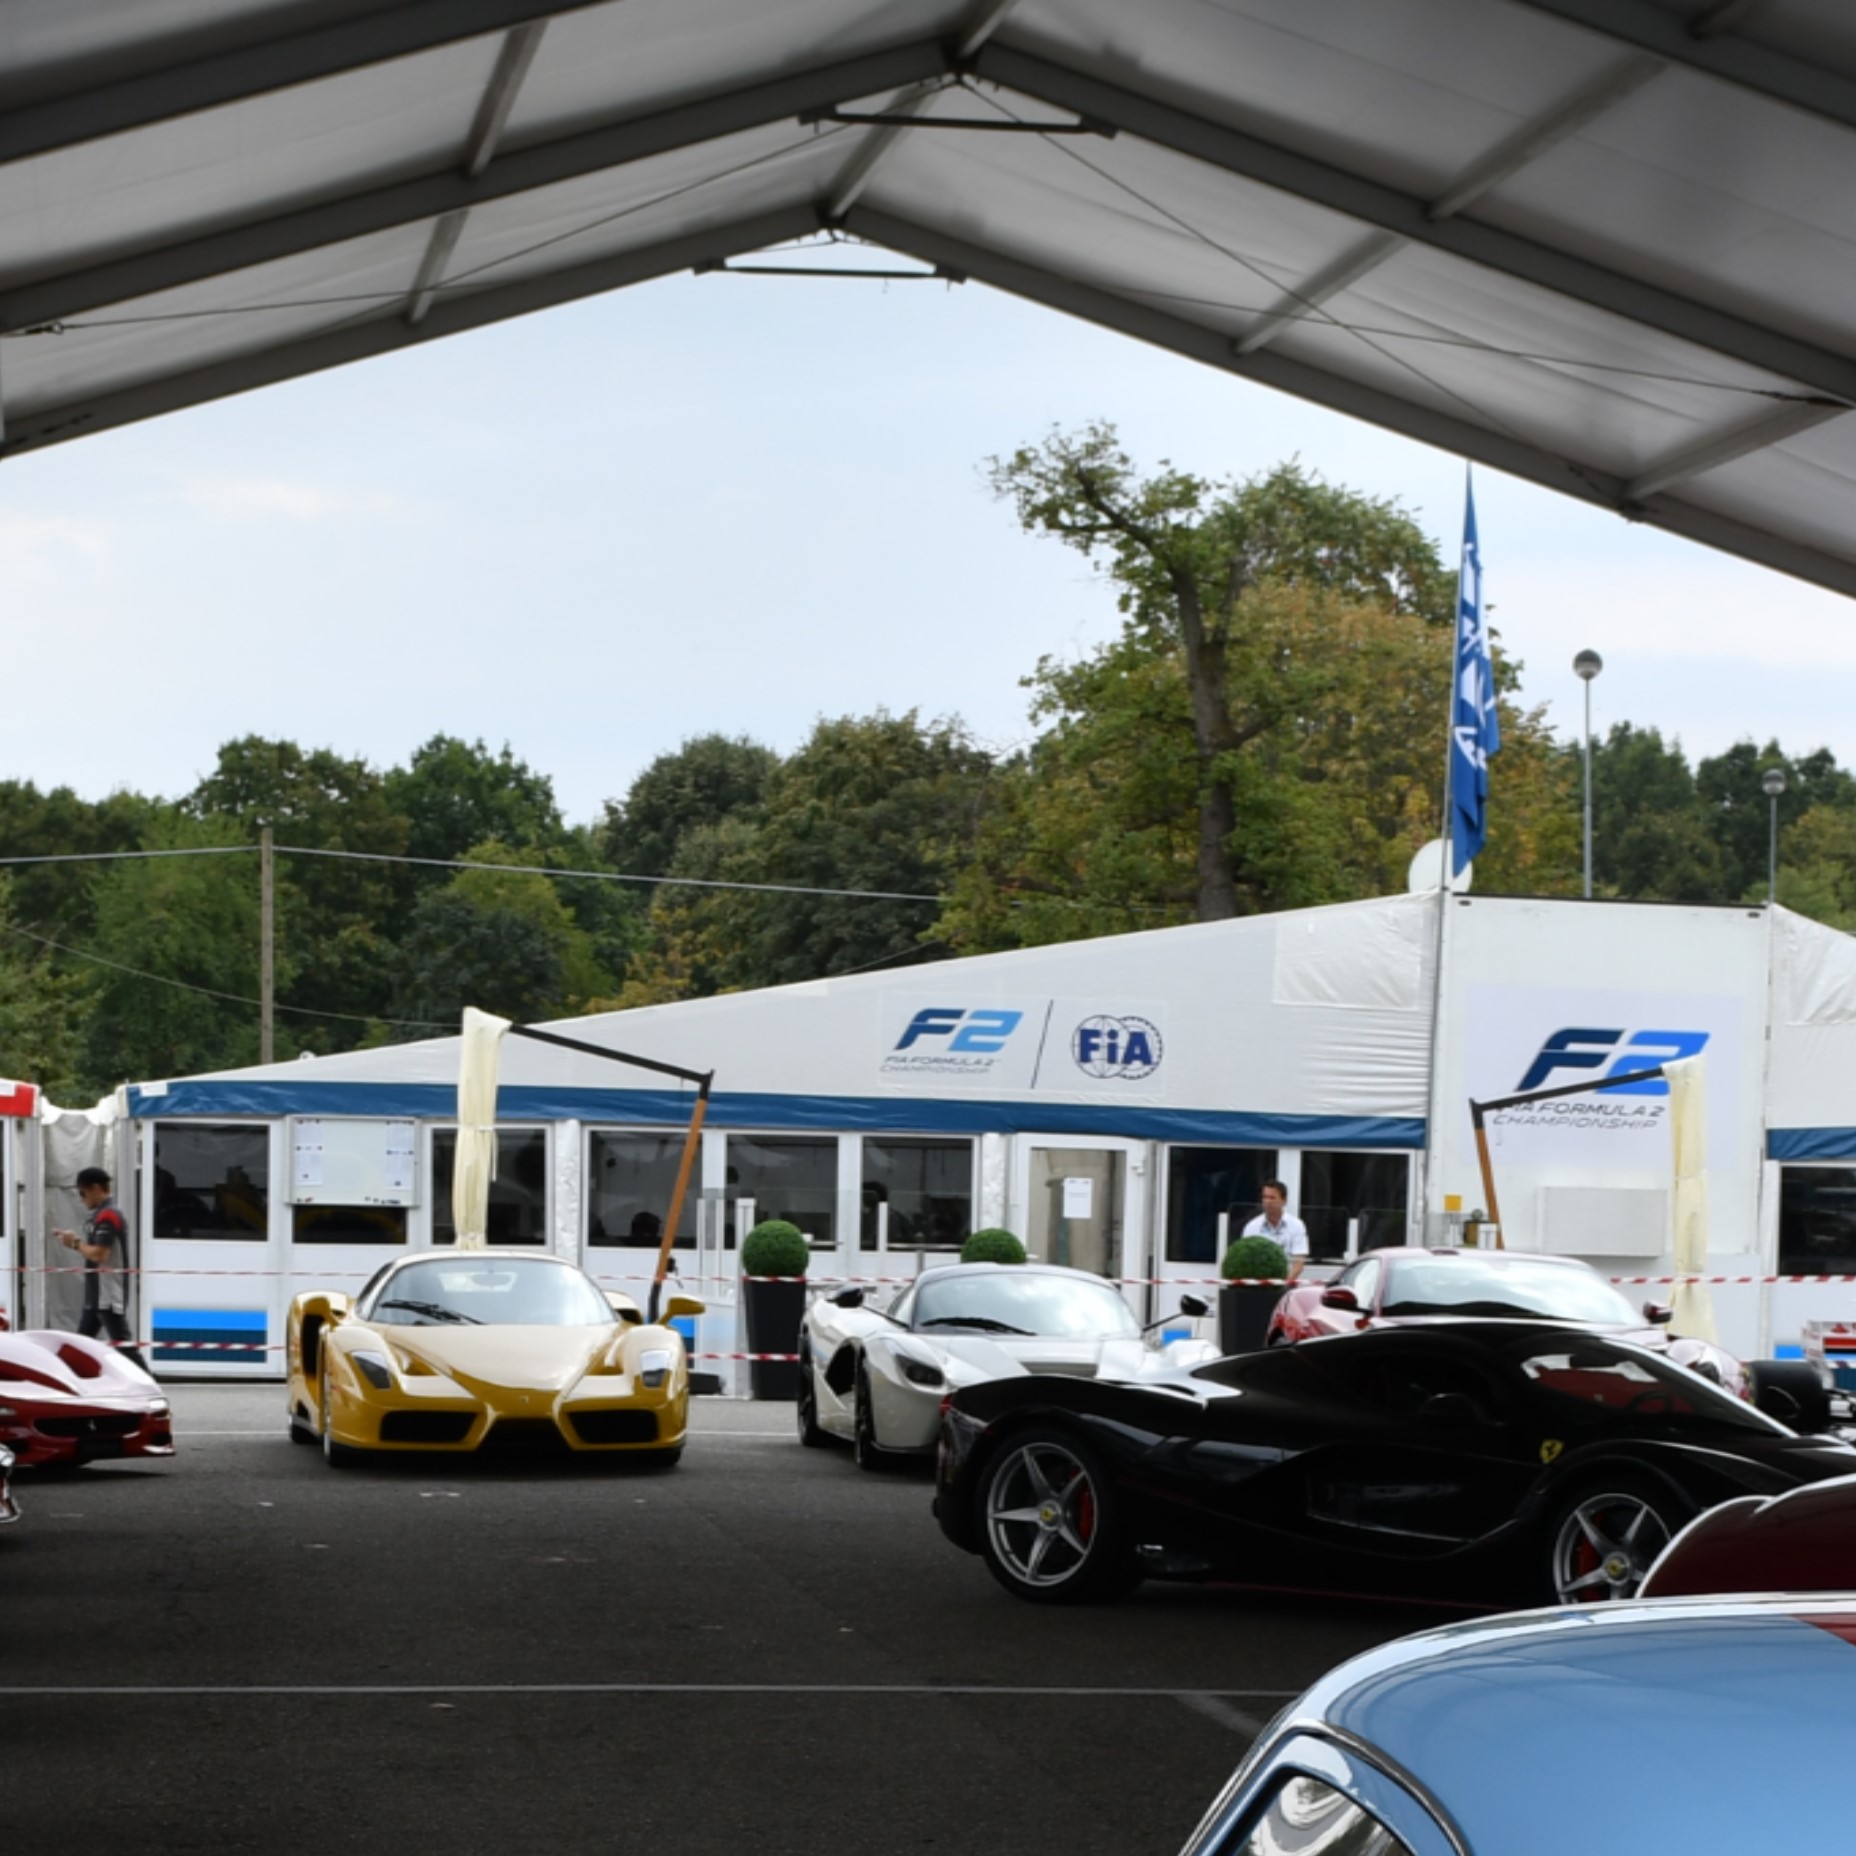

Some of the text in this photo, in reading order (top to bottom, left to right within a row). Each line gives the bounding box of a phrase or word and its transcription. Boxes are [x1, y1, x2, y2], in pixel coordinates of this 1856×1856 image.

[894, 1008, 1024, 1053] F2
[1513, 1027, 1710, 1096] F2
[1493, 1114, 1658, 1129] CHAMPIONSHIP
[1496, 1101, 1665, 1117] IA FORMULA 2
